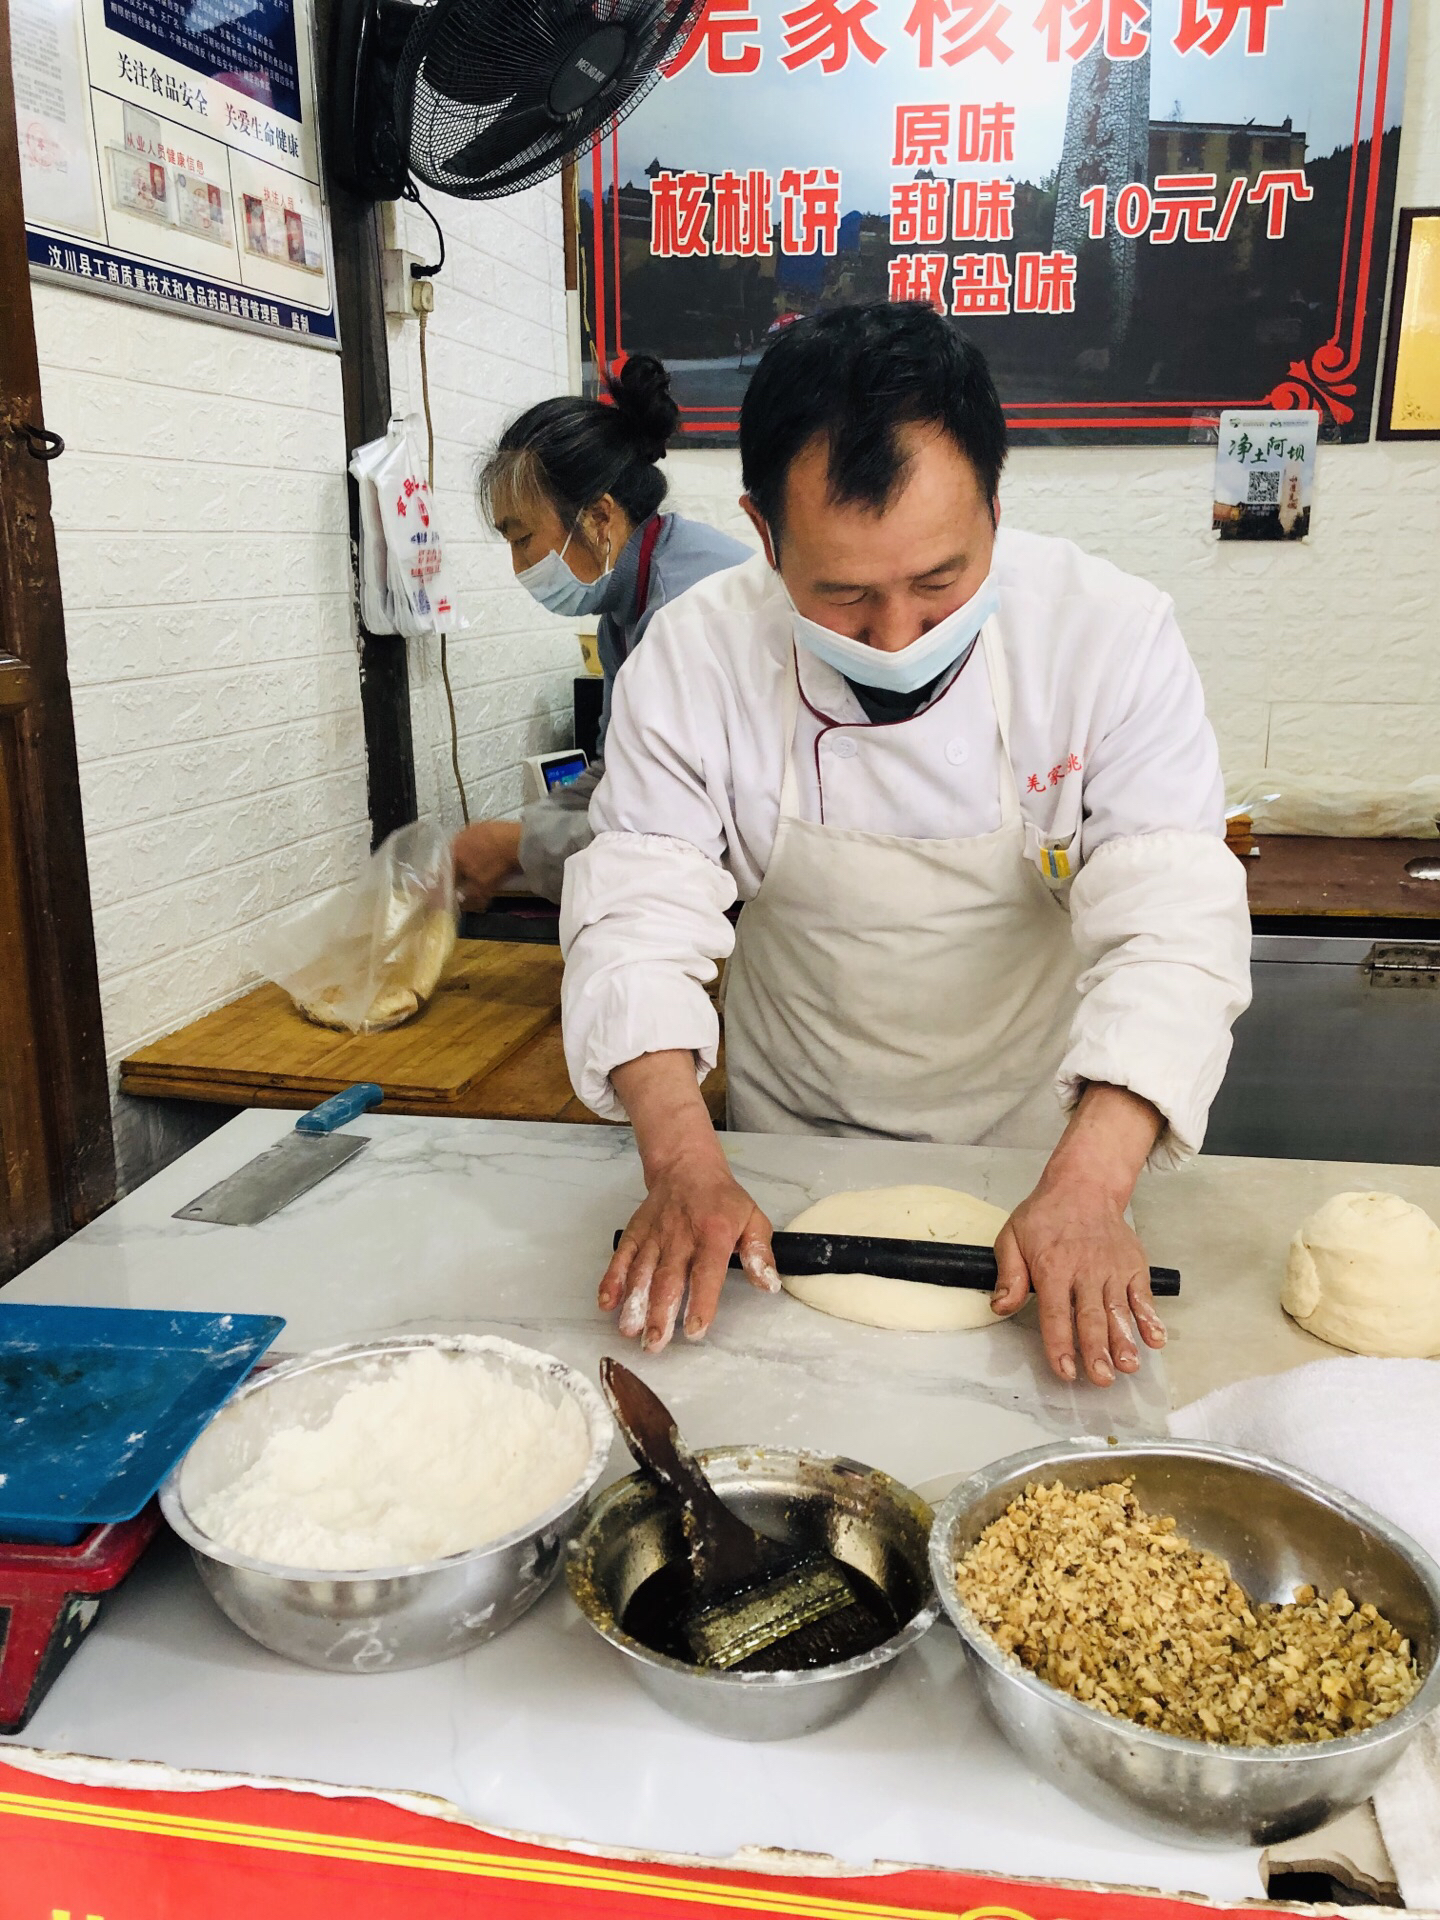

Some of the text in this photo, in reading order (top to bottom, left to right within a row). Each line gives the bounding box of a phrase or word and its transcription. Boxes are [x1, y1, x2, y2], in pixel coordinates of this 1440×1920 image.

[117, 51, 209, 117] 关注食品安全
[224, 101, 300, 158] 关爱生命健康
[891, 101, 1016, 167] 原味
[126, 132, 205, 176] 从业人员健康信息
[650, 168, 842, 258] 核桃饼
[890, 178, 1015, 245] 甜味
[1080, 169, 1314, 244] 10元/个
[47, 244, 310, 334] 汶川县工商质量技术和食品药品监督管理局 监制
[887, 250, 1077, 316] 椒盐味
[1228, 432, 1305, 464] 净土阿坝
